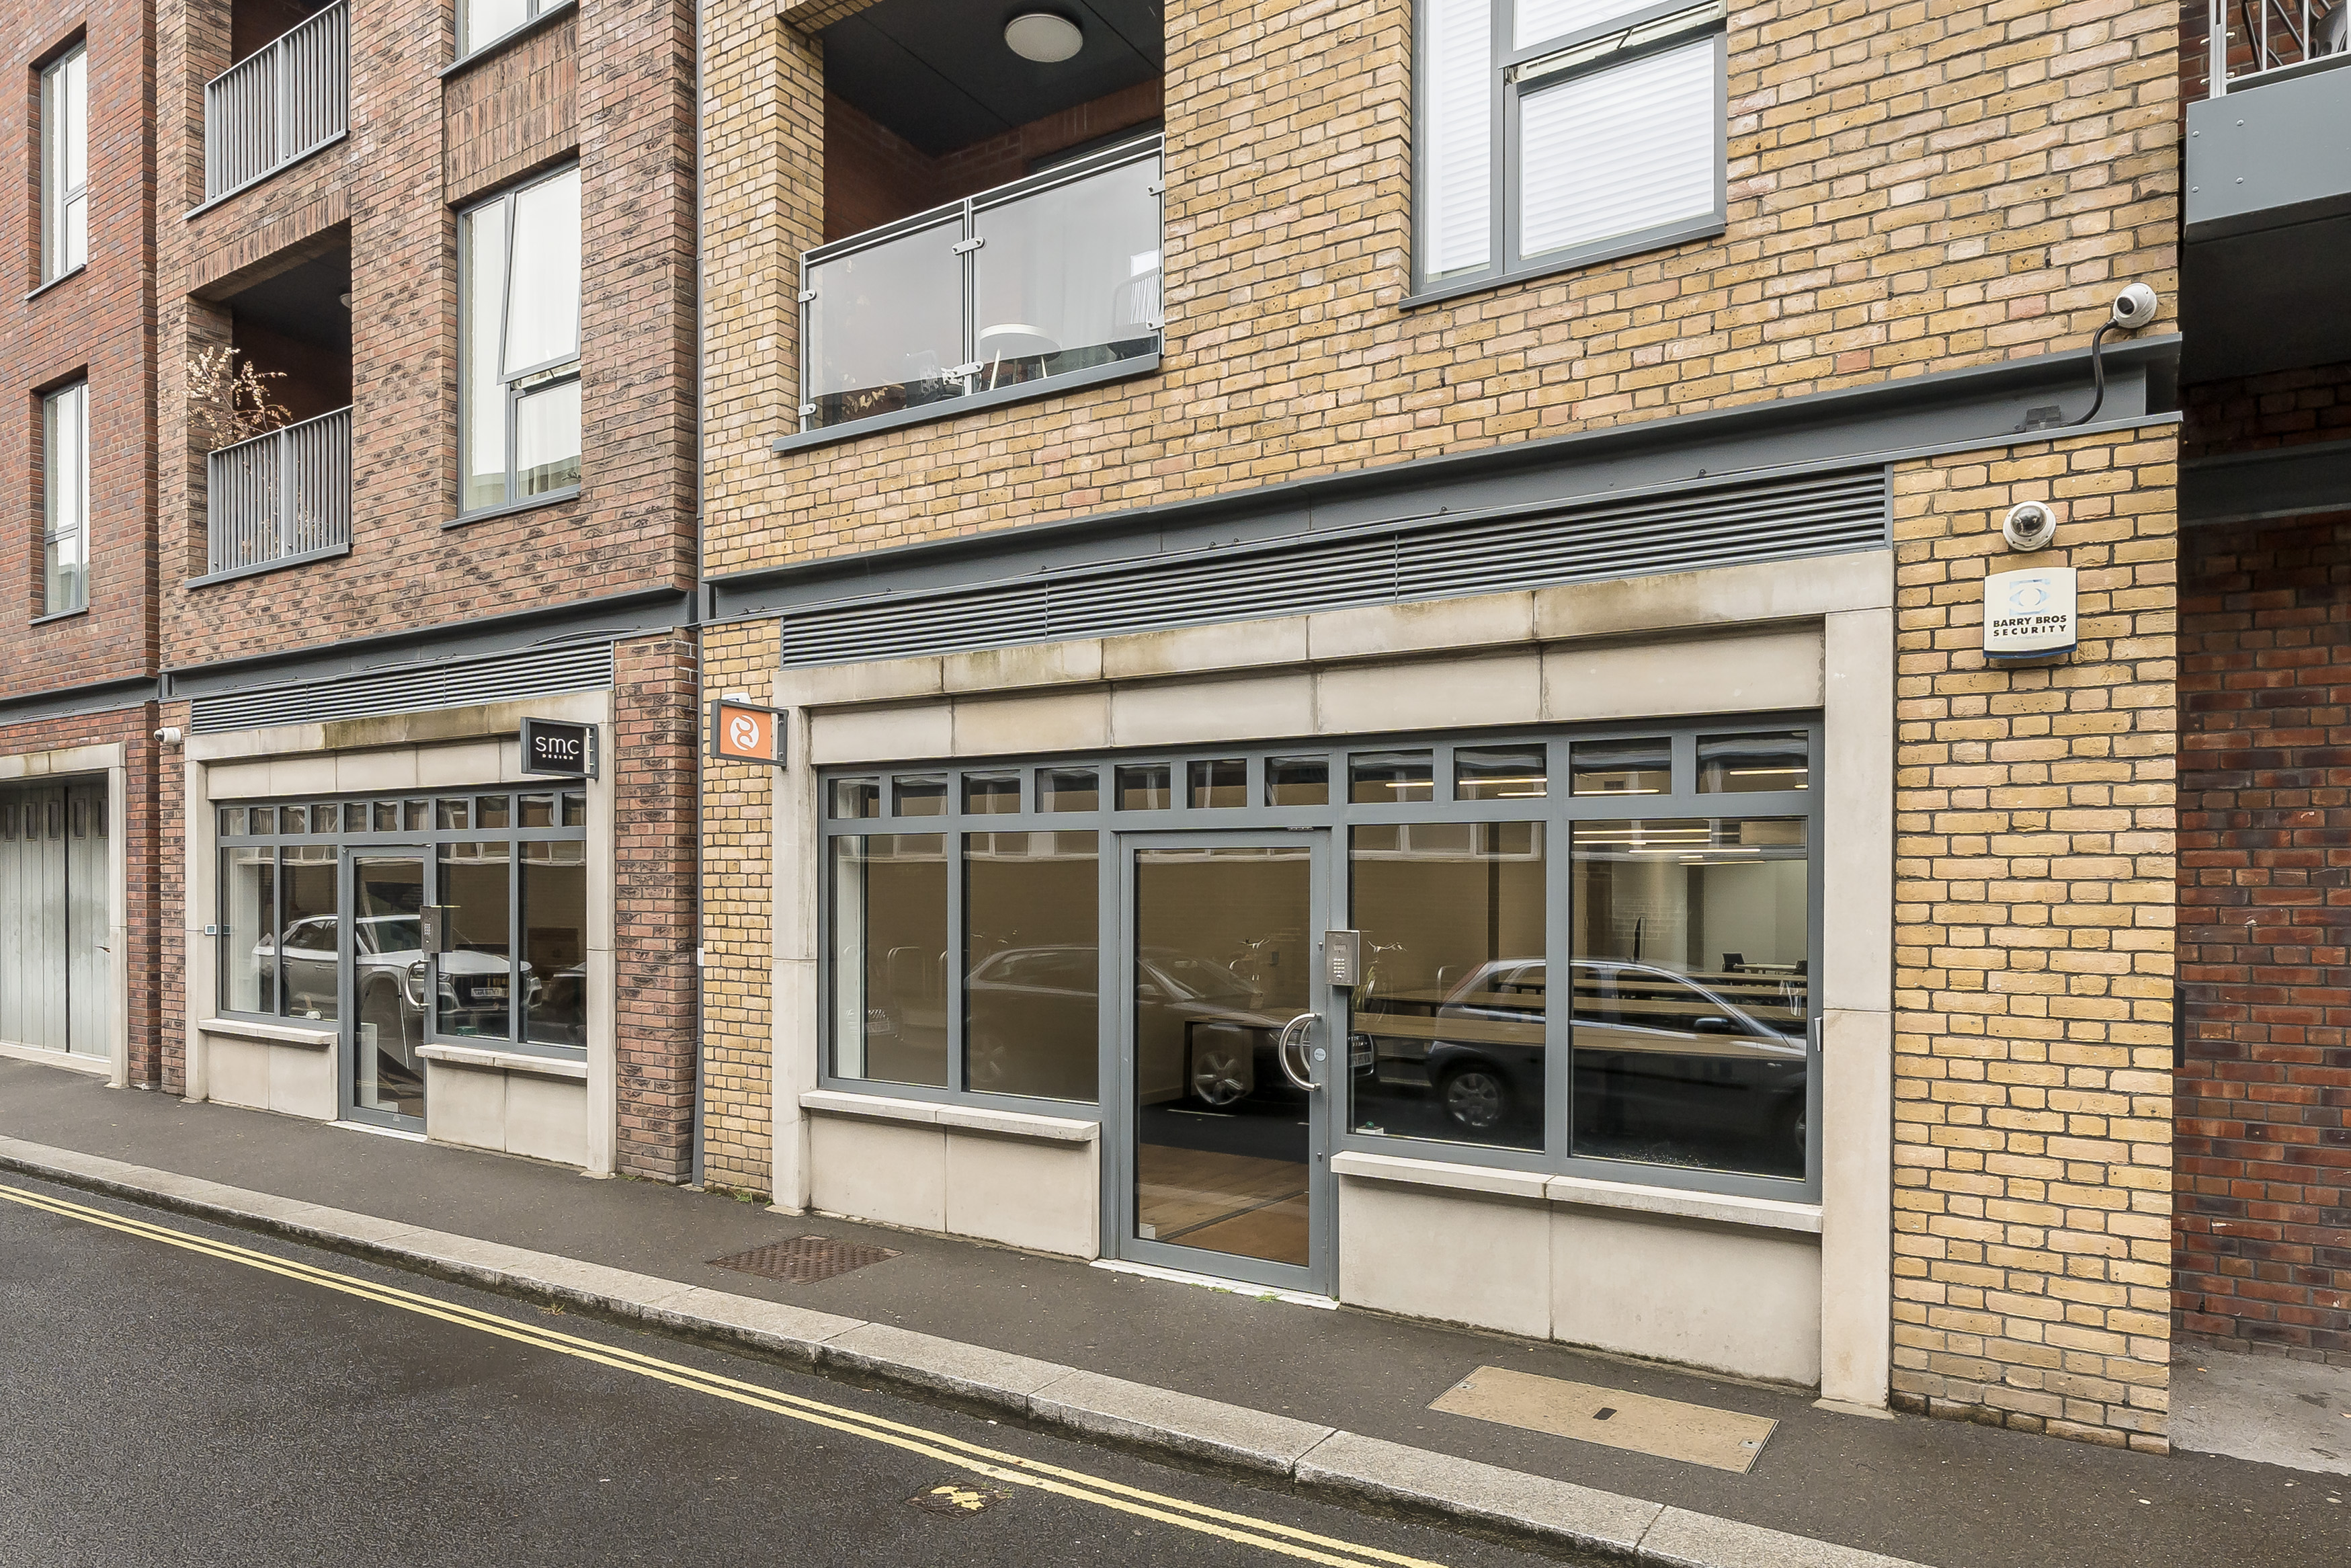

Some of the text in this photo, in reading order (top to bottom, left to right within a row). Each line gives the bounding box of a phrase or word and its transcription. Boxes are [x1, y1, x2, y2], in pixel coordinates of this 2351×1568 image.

[1993, 615, 2067, 627] BARRY BROS
[1993, 625, 2067, 636] SECURITY
[536, 737, 579, 754] smc
